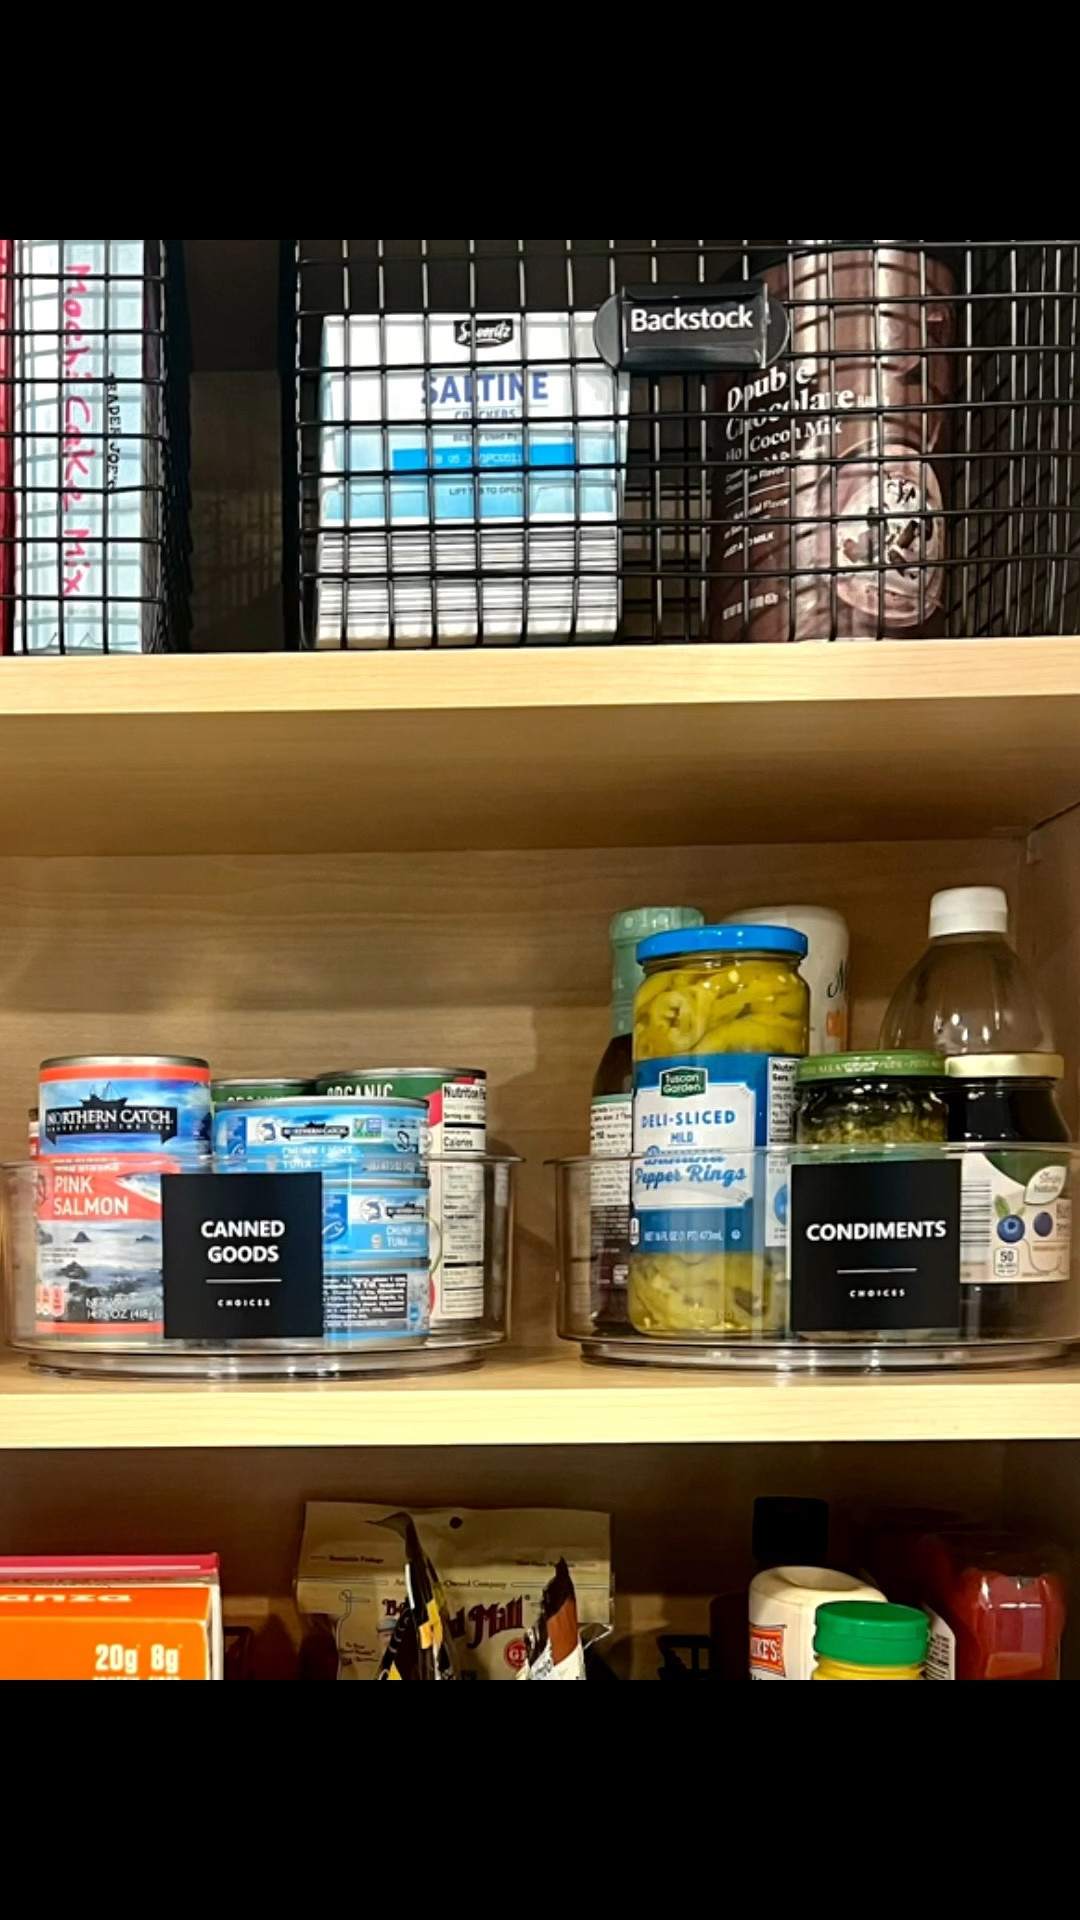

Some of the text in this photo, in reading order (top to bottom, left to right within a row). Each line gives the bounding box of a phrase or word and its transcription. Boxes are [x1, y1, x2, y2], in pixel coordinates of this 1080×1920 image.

[631, 304, 754, 332] Backstock
[422, 372, 549, 404] SALTINE
[63, 264, 95, 597] Mochi Cake Mix
[664, 1073, 700, 1084] Tuscan
[444, 1086, 478, 1098] Nutrition
[662, 1083, 702, 1093] Garden
[47, 1109, 117, 1125] NORTHERN
[444, 1136, 473, 1148] Calories
[670, 1131, 695, 1143] MILD
[53, 1175, 94, 1194] PINK
[634, 1166, 684, 1190] Pepper
[686, 1164, 748, 1188] Rings
[53, 1196, 129, 1216] SALMON
[200, 1219, 286, 1238] CANNED
[805, 1220, 947, 1242] CONDIMENTS
[207, 1245, 280, 1263] GOODS
[1000, 1251, 1014, 1263] 50
[849, 1288, 905, 1298] CHOICES
[217, 1298, 271, 1308] CHOICES
[466, 1594, 524, 1649] Mill
